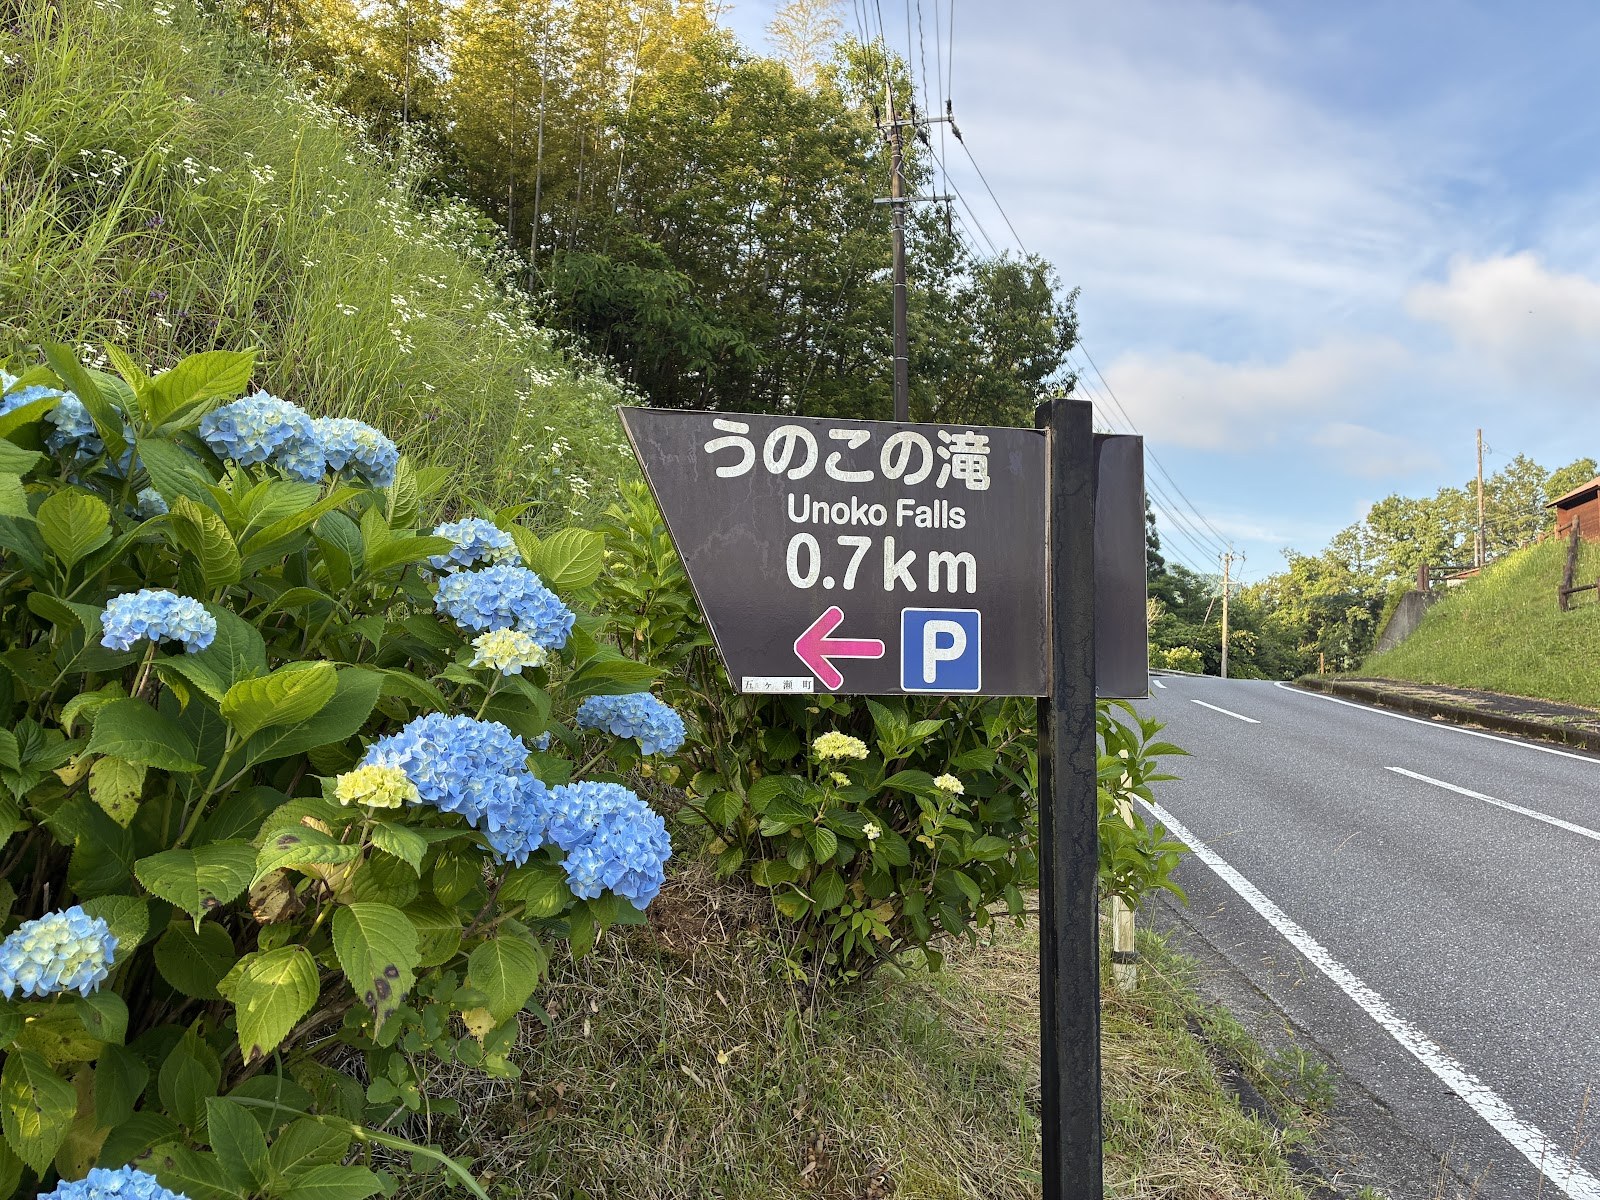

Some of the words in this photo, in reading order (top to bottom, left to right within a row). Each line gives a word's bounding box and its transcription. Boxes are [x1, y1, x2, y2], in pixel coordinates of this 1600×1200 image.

[704, 418, 991, 491] うのこの滝
[788, 493, 887, 526] Unoko
[897, 499, 966, 529] Falls
[923, 620, 966, 683] P
